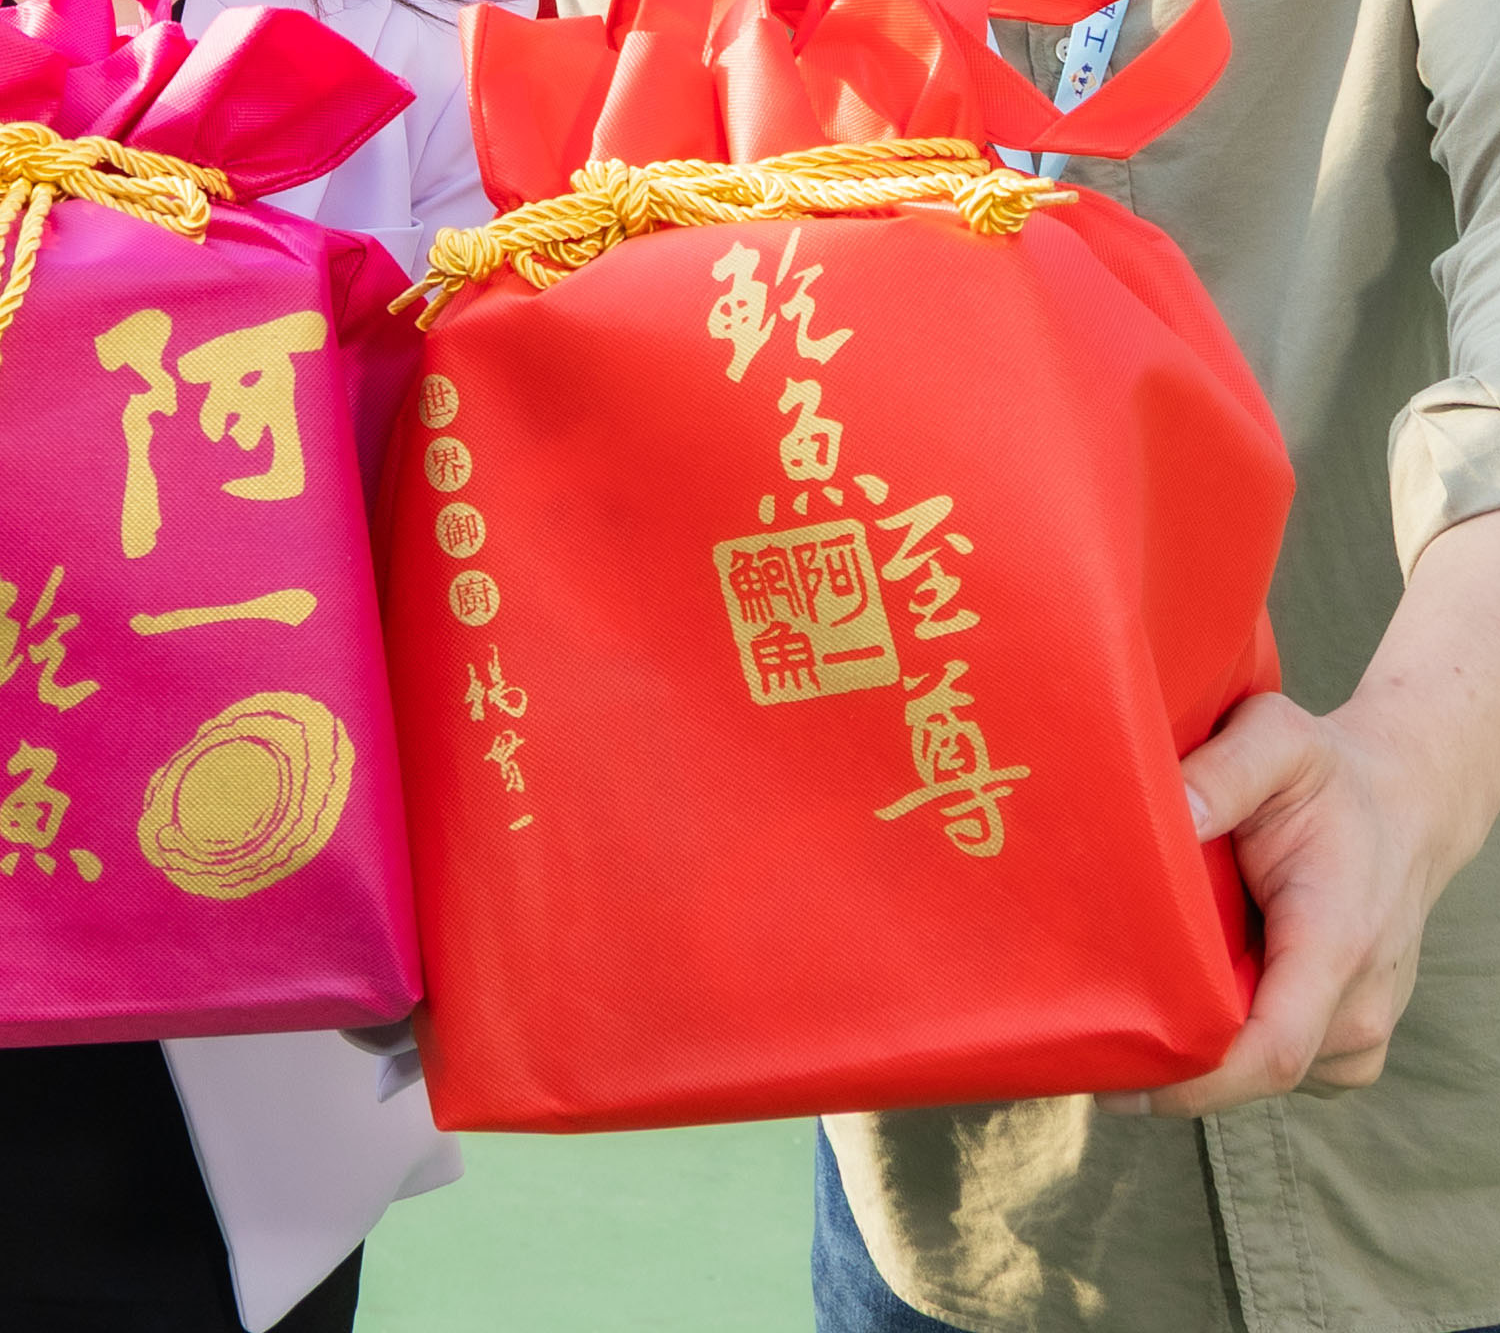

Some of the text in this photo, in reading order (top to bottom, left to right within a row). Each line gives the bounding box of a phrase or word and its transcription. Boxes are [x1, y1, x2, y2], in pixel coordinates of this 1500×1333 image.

[95, 308, 329, 636] 阿一
[419, 377, 534, 831] 世界御廚 楊貫一
